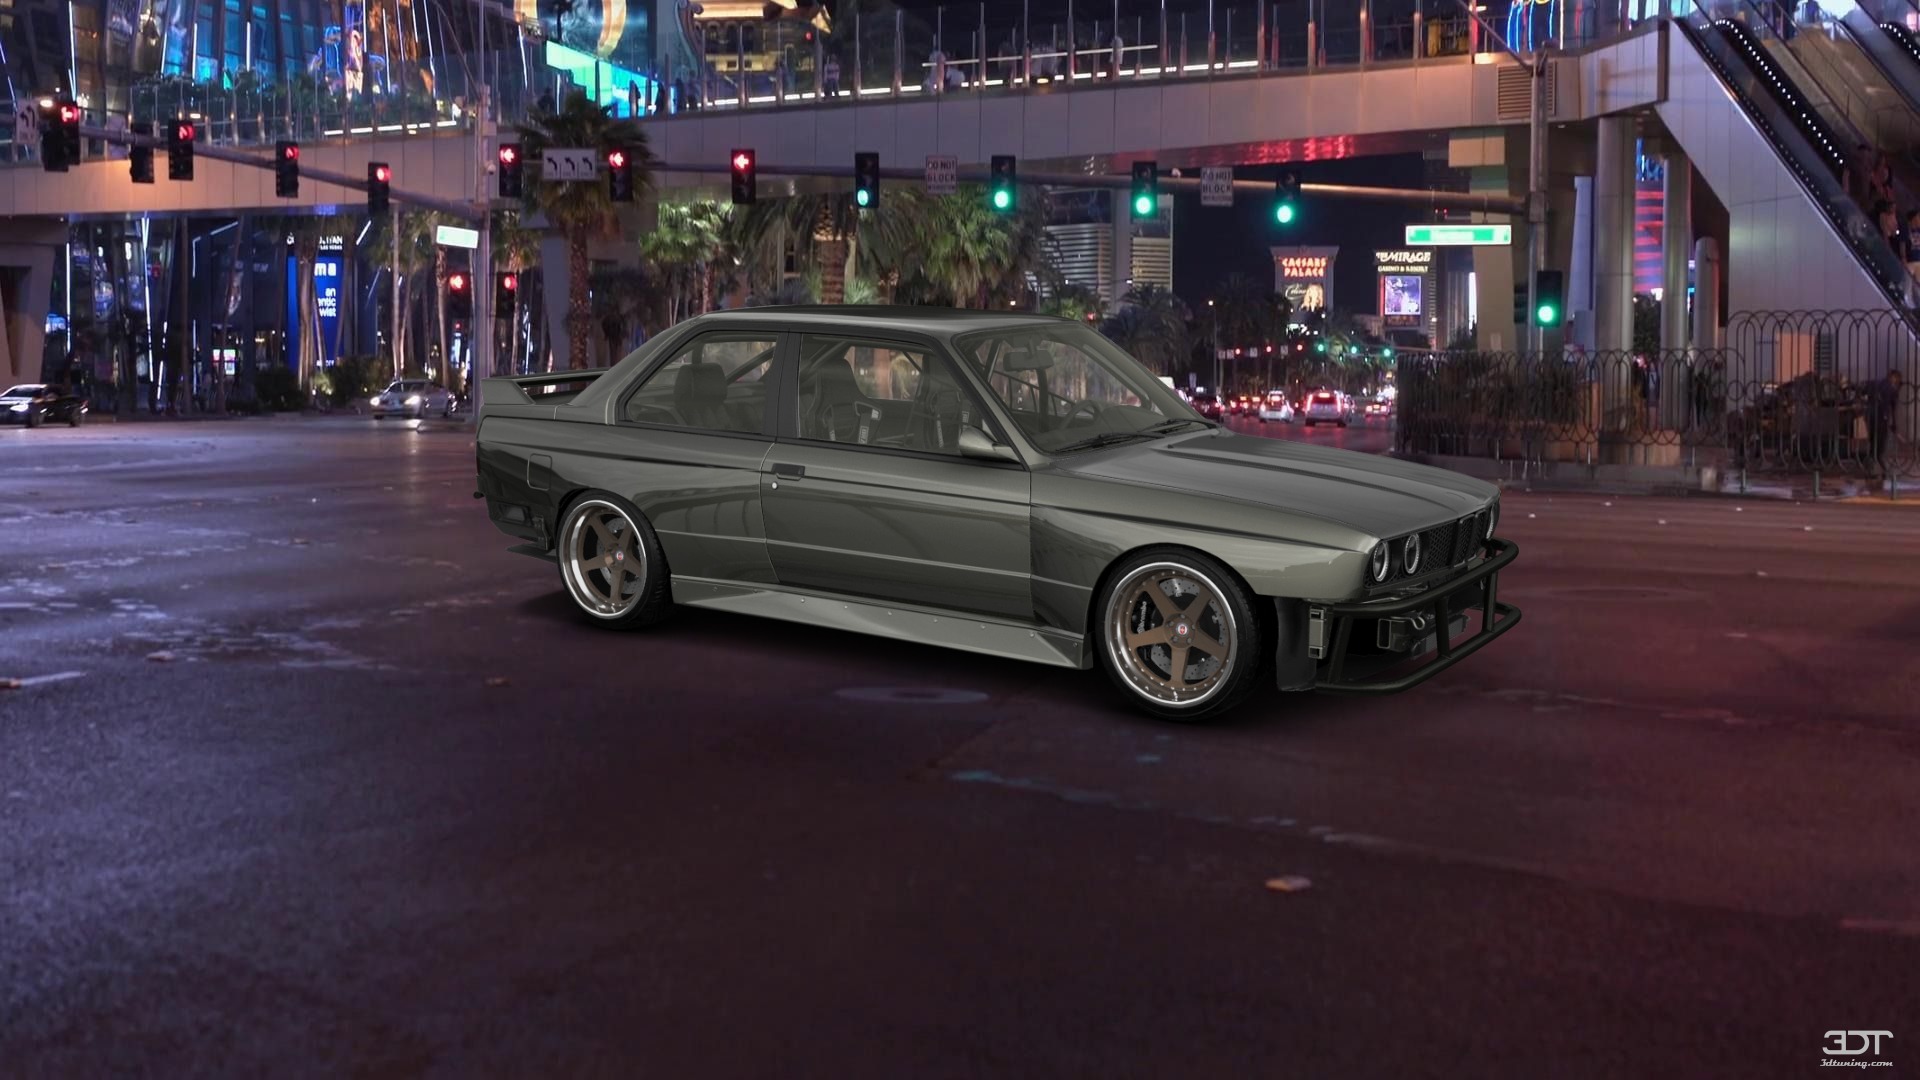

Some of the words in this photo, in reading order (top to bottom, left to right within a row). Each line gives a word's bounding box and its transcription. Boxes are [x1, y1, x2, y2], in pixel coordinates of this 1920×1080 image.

[928, 173, 956, 182] BLOCK
[1202, 184, 1231, 193] BLOCK
[1282, 257, 1327, 267] CAESARS
[1382, 252, 1431, 263] MIRAGE
[1284, 267, 1324, 277] PALACE
